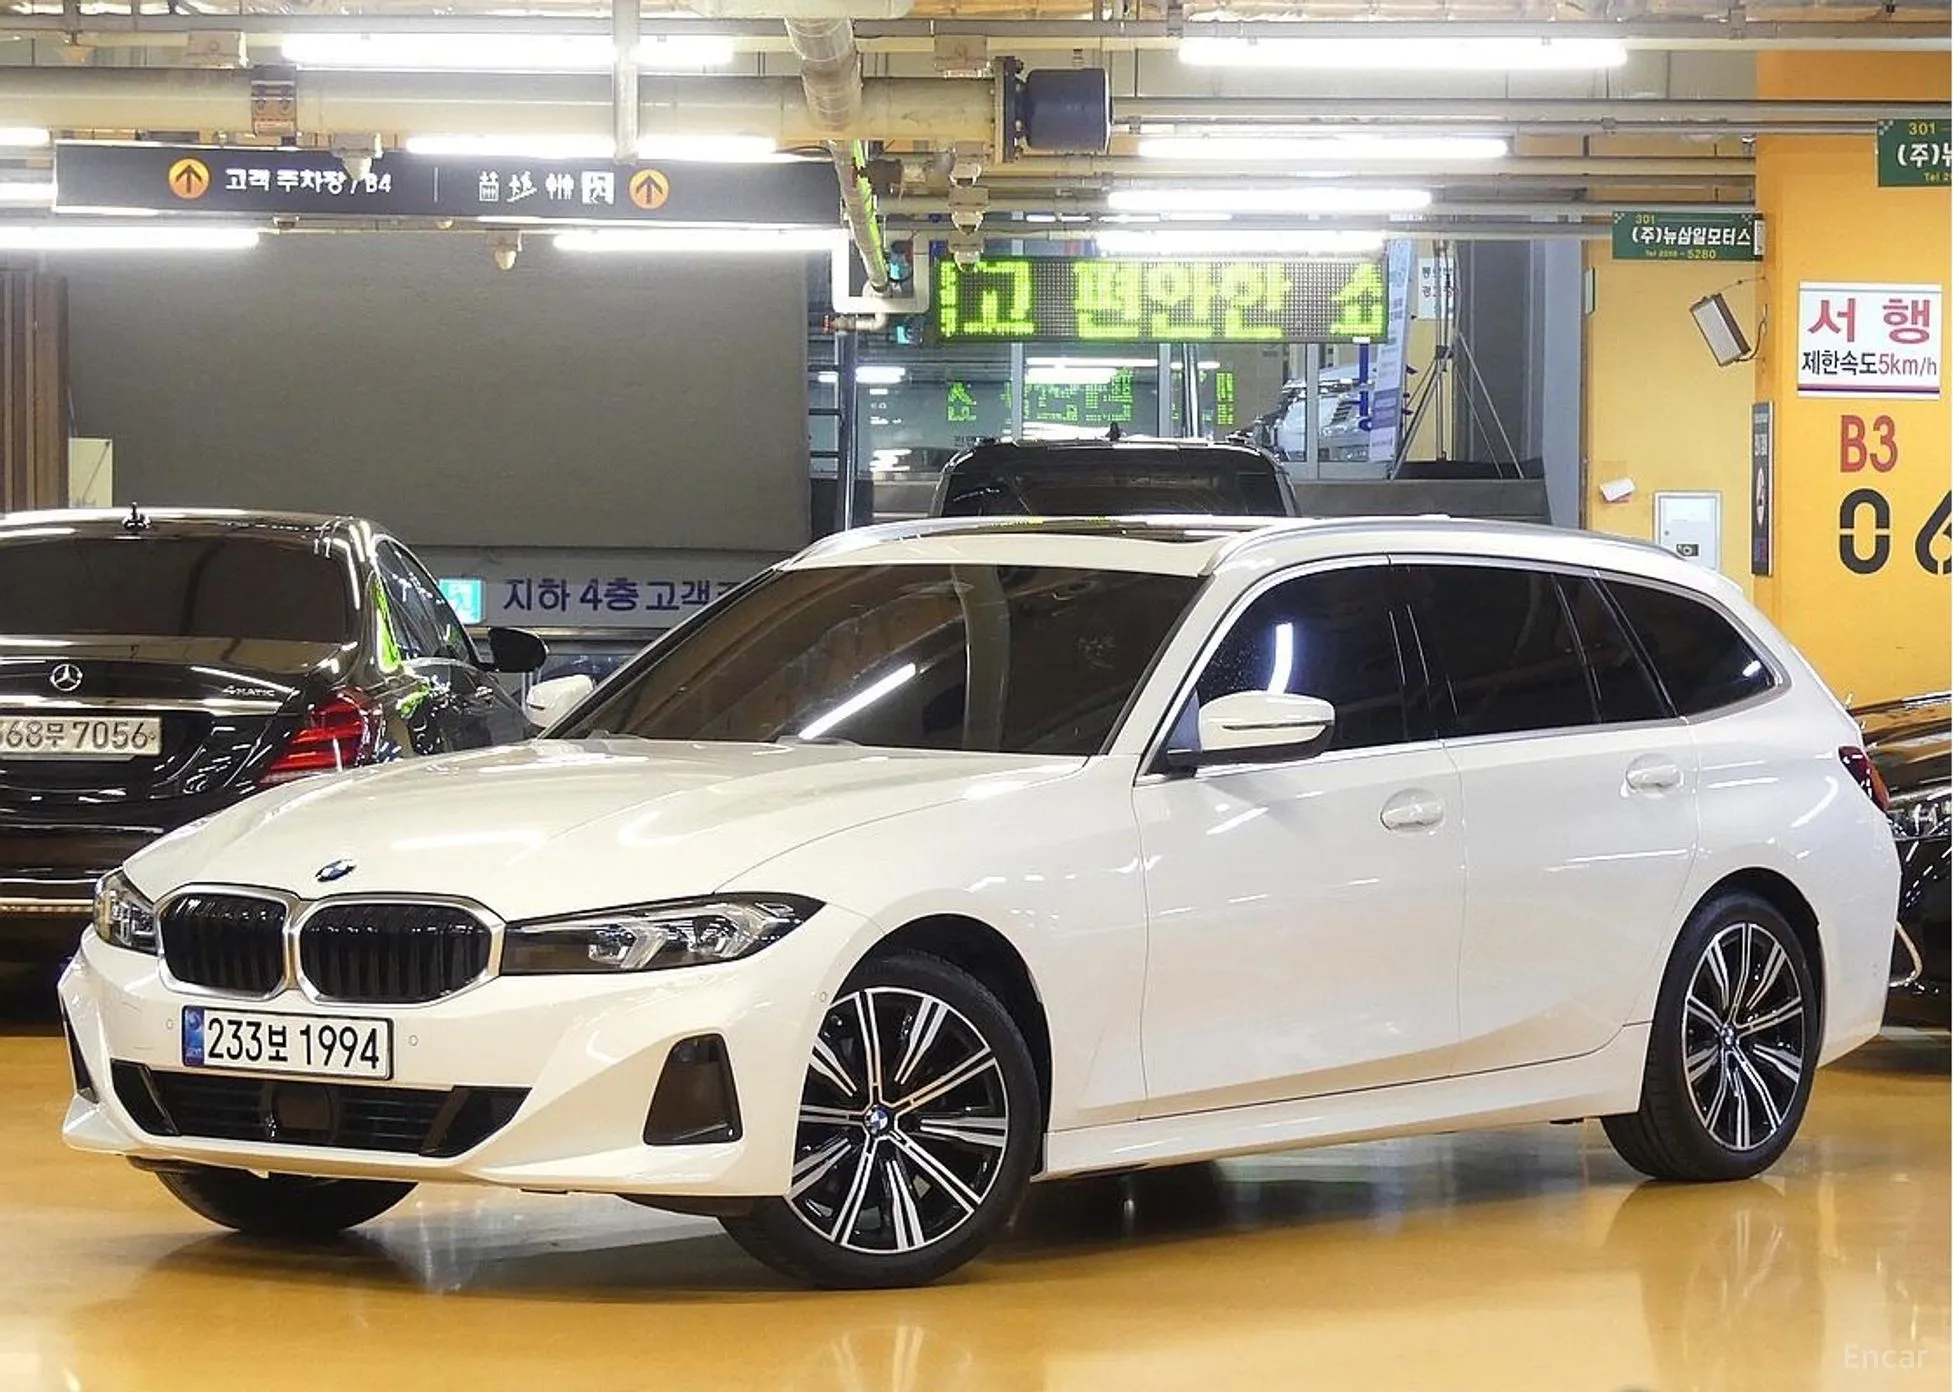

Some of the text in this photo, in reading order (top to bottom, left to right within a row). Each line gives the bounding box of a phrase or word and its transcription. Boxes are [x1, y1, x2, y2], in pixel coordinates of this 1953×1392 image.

[1908, 122, 1936, 136] 301
[225, 168, 271, 191] 고객
[277, 168, 347, 195] 주차장
[365, 172, 392, 193] B4
[1635, 214, 1655, 225] 301
[1631, 225, 1751, 246] (주)뉴삼일모터스
[1687, 248, 1717, 259] 5280
[940, 260, 1035, 338] 고
[1840, 414, 1899, 473] B3
[503, 578, 570, 612] 지하
[580, 577, 639, 612] 4층
[222, 685, 275, 697] 4MATIC
[0, 720, 149, 750] 68무 7056
[208, 1017, 380, 1069] 233보 1994
